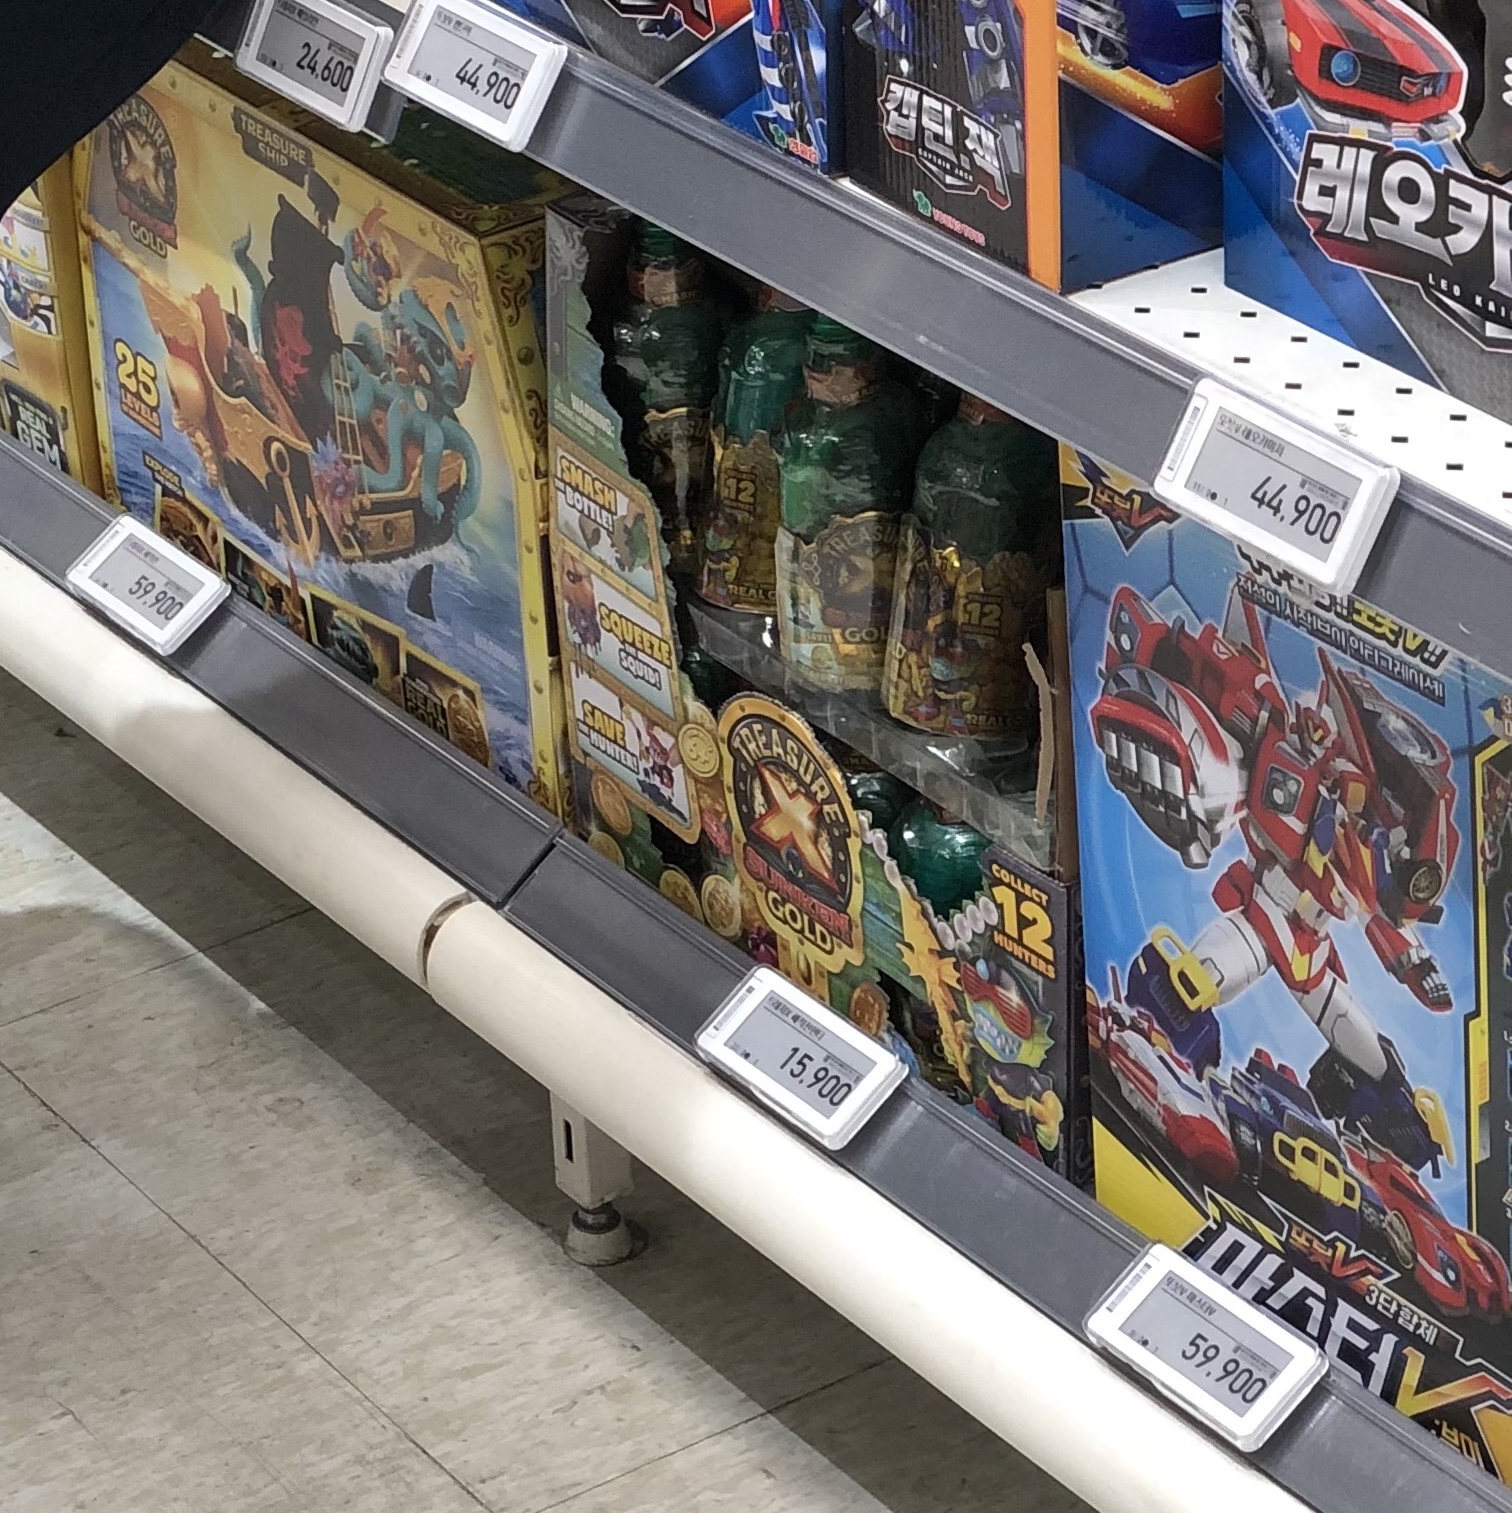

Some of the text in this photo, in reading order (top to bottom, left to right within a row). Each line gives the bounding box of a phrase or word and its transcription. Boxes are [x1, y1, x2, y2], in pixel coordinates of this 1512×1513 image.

[296, 42, 354, 92] 24.600
[455, 58, 521, 110] 44.900
[113, 99, 173, 161] TREASURE
[239, 113, 307, 165] TREASURE
[258, 142, 288, 168] SHIP
[918, 148, 973, 182] CAPTAIN JACK
[130, 220, 167, 258] GOLD
[1302, 142, 1512, 298] 레오카
[1428, 273, 1512, 322] LEO KAI
[115, 340, 159, 407] 25
[19, 405, 50, 438] REAL
[121, 388, 159, 428] LEVELS
[16, 420, 61, 470] GEM
[561, 457, 617, 515] SMASH
[565, 486, 614, 533] BOTTLE!
[724, 478, 755, 504] 12
[1250, 476, 1342, 544] 44.900
[128, 575, 184, 620] 59.900
[965, 604, 1002, 627] 12
[599, 602, 672, 669] SQUEEZE
[844, 625, 890, 644] GOL
[619, 649, 661, 691] SQUID!
[583, 700, 625, 746] SAVE
[589, 729, 638, 774] HUNTER!
[733, 722, 845, 825] TREASURE
[744, 845, 853, 947] SUNKEN
[991, 863, 1048, 904] COLLECT
[766, 888, 834, 954] GOLD
[992, 884, 1054, 962] 12
[993, 931, 1055, 979] HUNTERS
[780, 1046, 853, 1106] 15.900
[1181, 1331, 1268, 1405] 59.900
